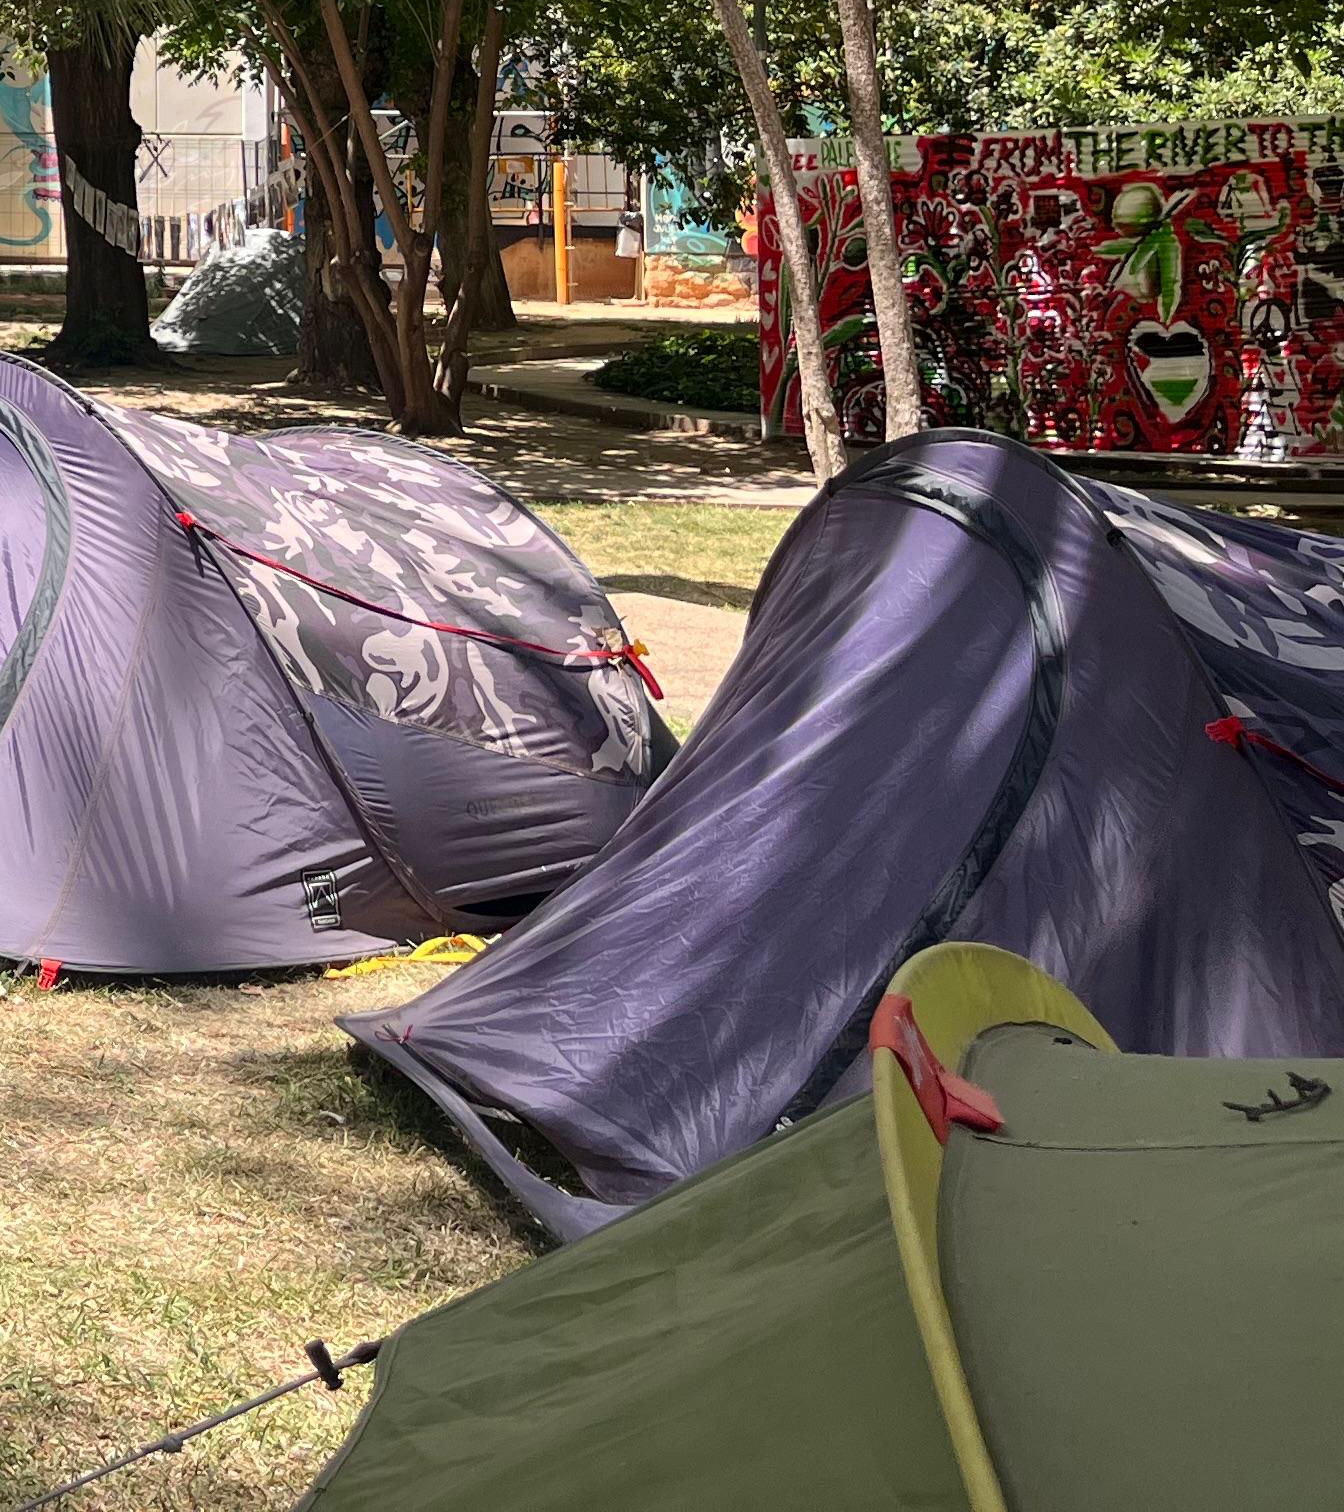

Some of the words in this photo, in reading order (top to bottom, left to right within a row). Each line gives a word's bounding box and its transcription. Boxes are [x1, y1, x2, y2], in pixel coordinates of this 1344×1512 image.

[977, 130, 1063, 178] FROM
[1063, 128, 1140, 175] THE
[1142, 122, 1249, 170] RIVER
[1247, 122, 1295, 160] TO
